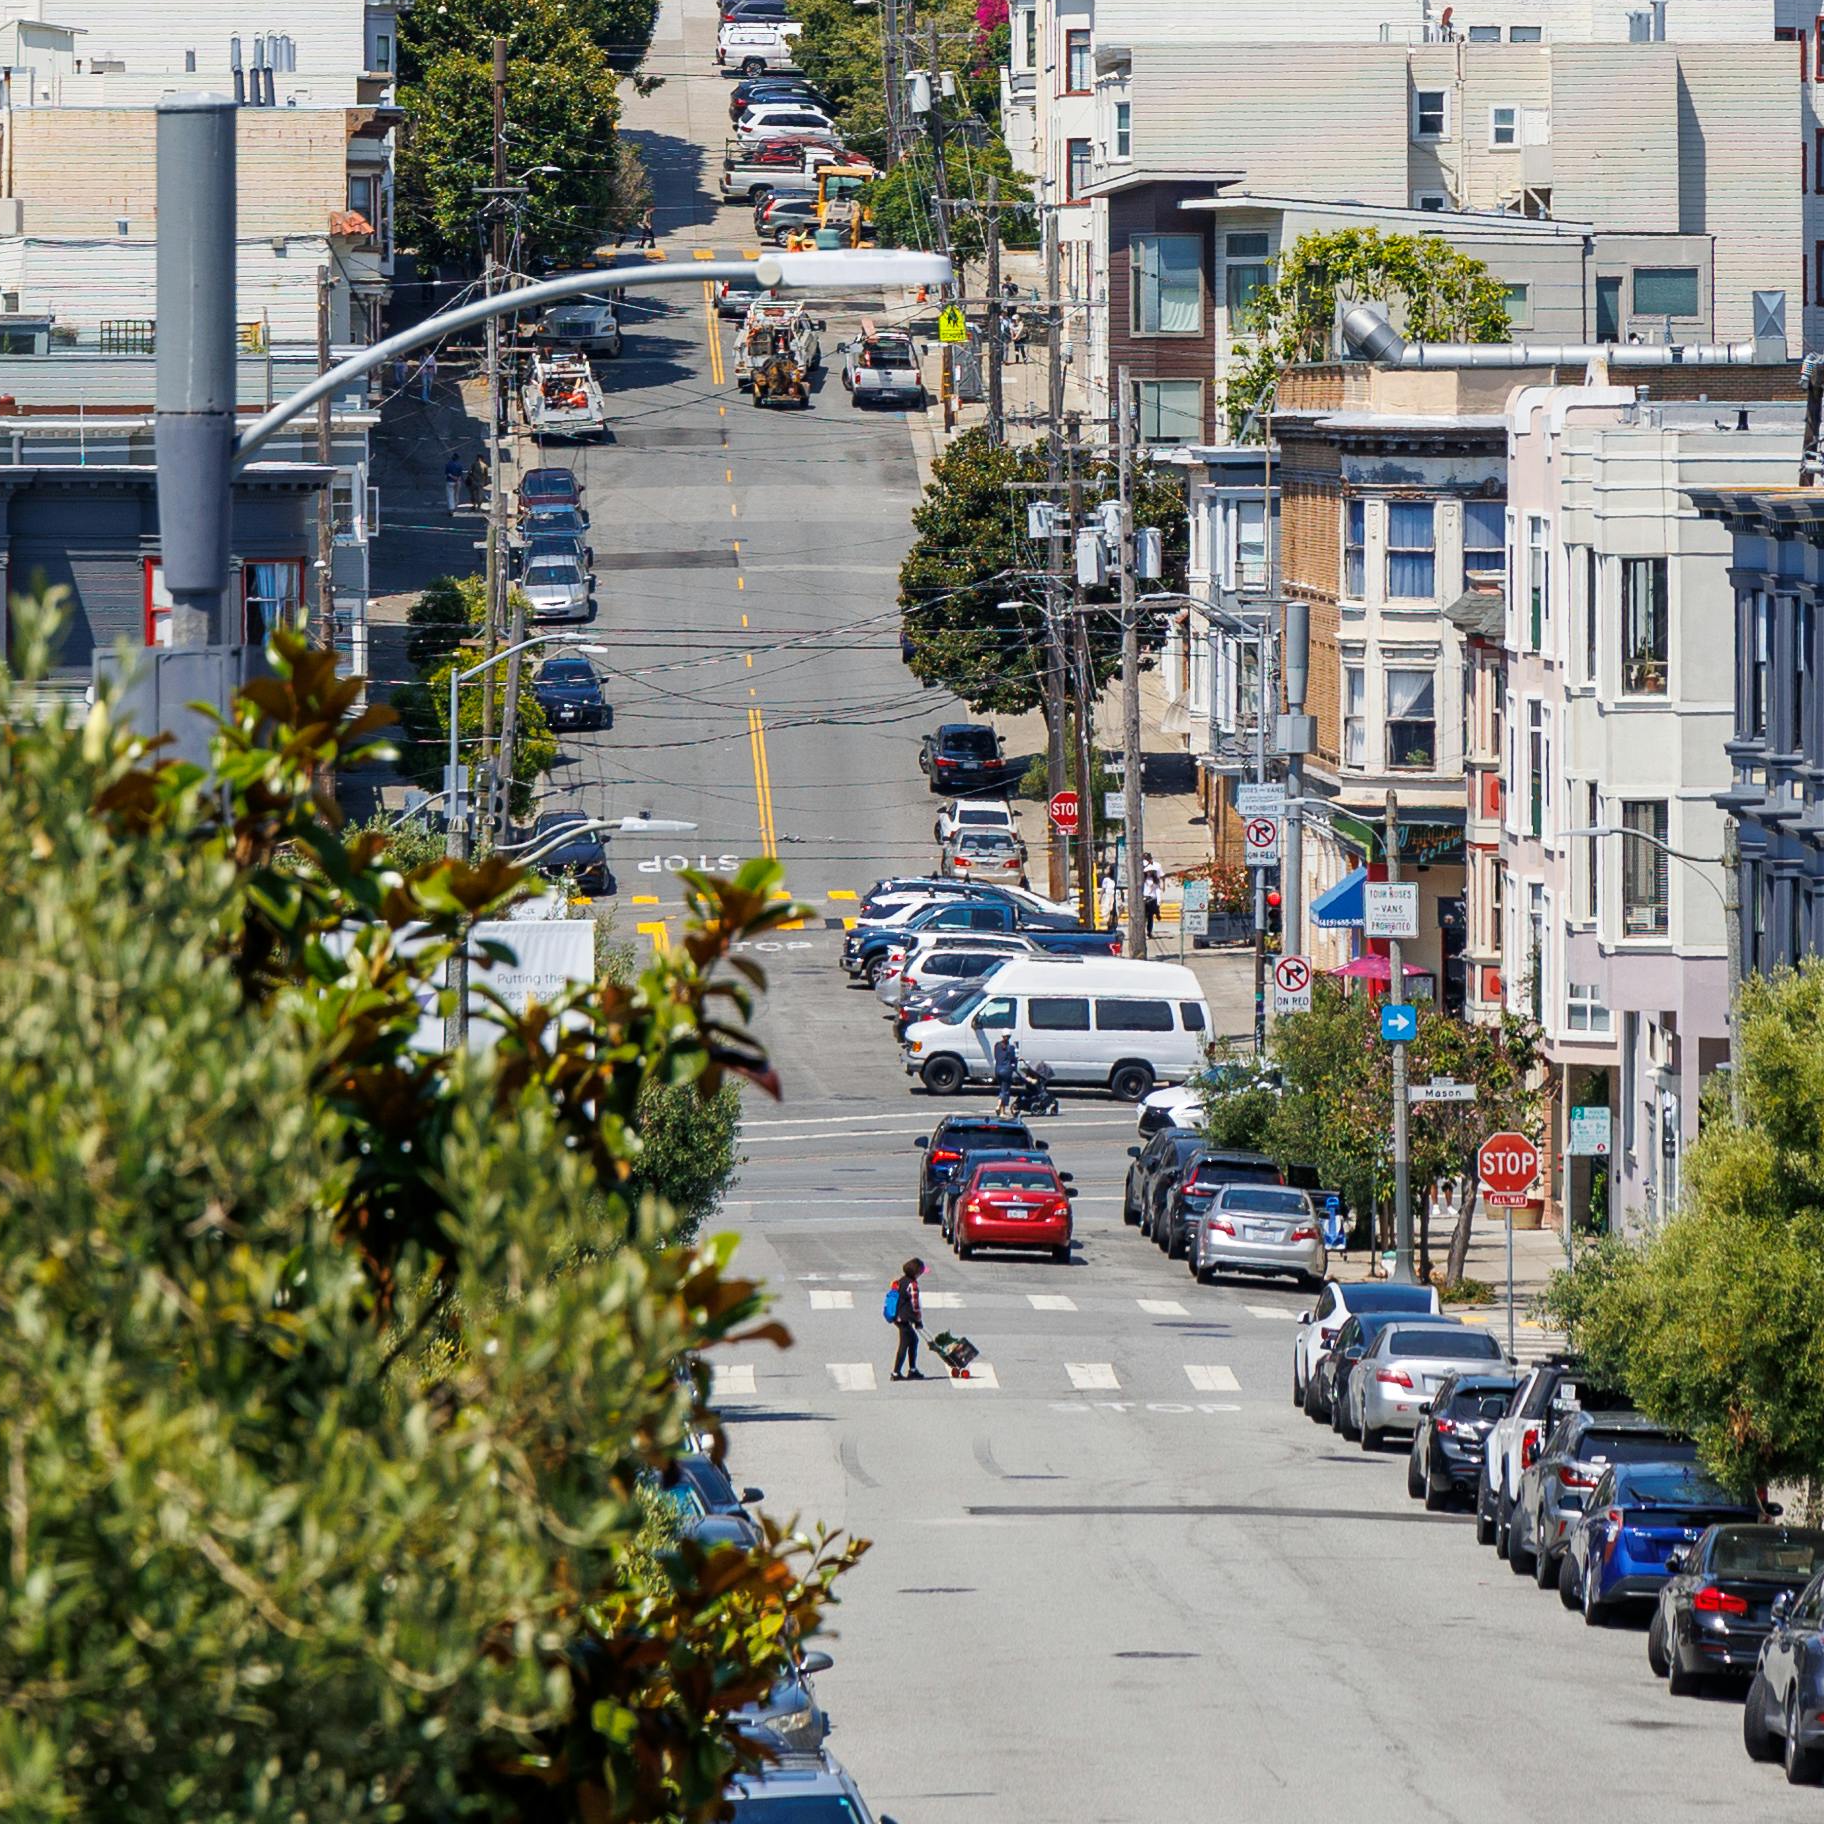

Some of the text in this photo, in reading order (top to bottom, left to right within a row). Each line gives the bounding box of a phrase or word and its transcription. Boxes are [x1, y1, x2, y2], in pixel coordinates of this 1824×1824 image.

[1260, 850, 1276, 860] RED
[1381, 904, 1404, 914] VANS
[729, 940, 813, 952] TOP
[497, 972, 565, 985] Putting the
[1276, 996, 1309, 1006] ON RED
[1425, 1088, 1463, 1098] Mason
[1482, 1151, 1535, 1175] STOP
[1493, 1195, 1525, 1204] ALL WAY
[1047, 1402, 1243, 1414] STOP
